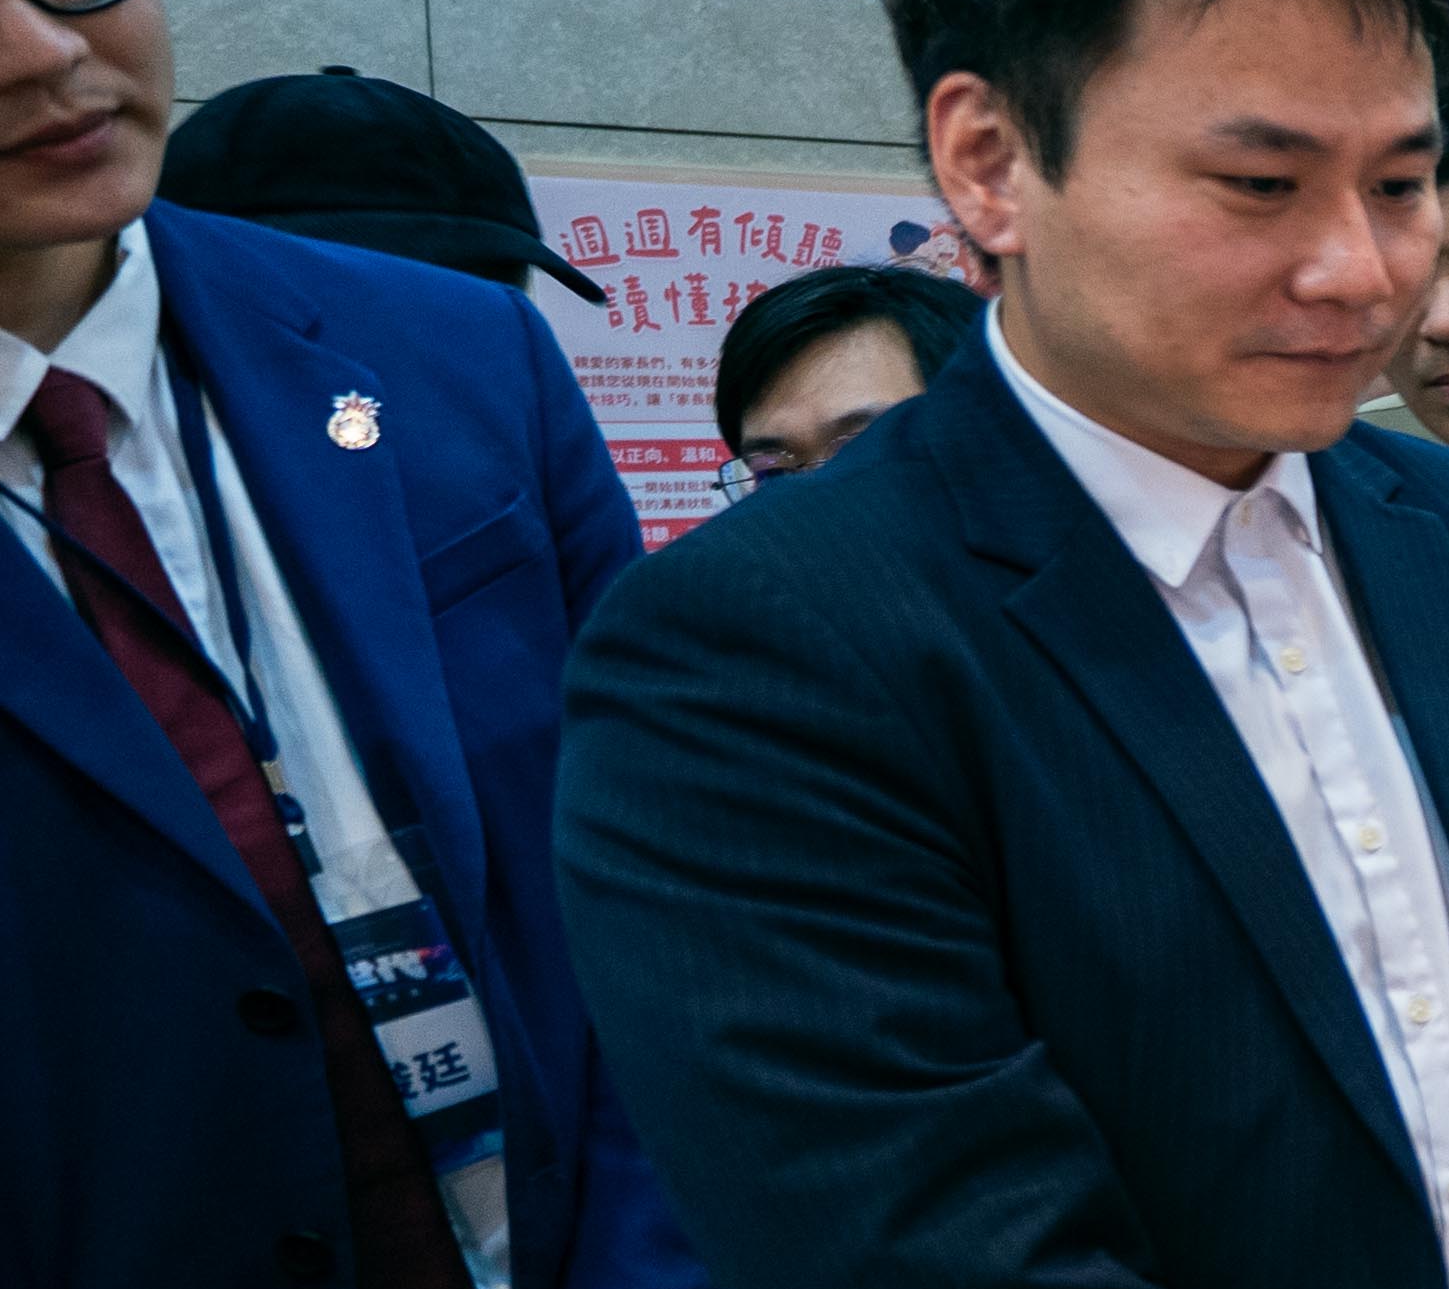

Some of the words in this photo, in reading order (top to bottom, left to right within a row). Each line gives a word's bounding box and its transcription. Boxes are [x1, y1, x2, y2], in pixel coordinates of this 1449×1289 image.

[560, 206, 843, 268] 週週有傾聽
